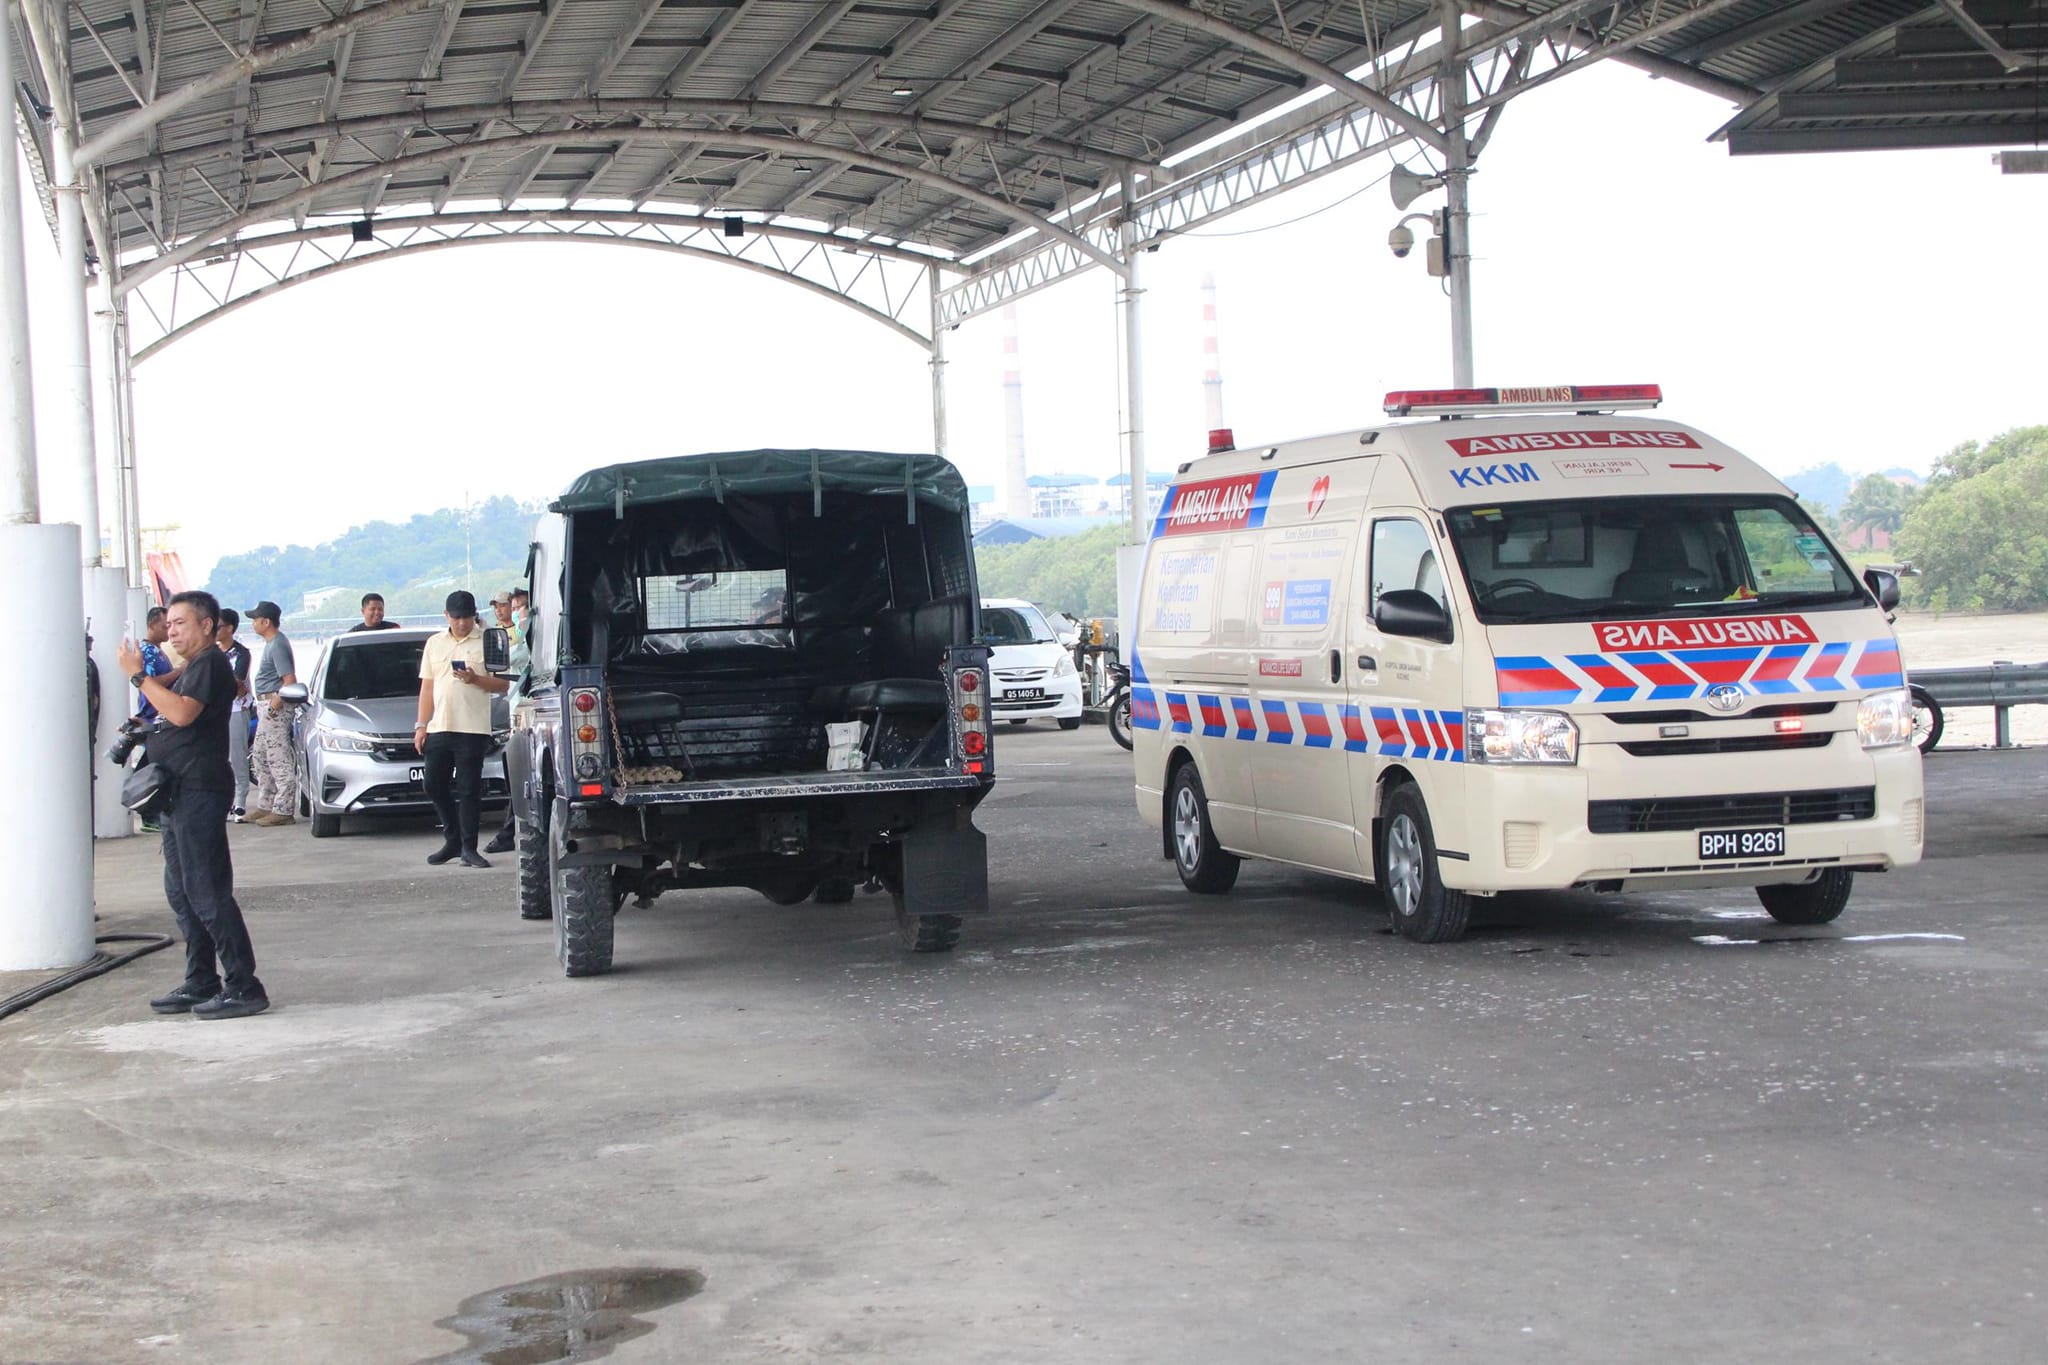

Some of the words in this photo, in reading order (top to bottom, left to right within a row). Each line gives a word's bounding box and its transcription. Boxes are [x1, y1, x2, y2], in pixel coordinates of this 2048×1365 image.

[1501, 387, 1571, 403] AMBULANS
[1469, 431, 1686, 453] AMBULANS
[1450, 462, 1541, 488] KKM
[1170, 483, 1253, 526] AMBULANS
[1266, 587, 1281, 609] 999
[1155, 607, 1192, 634] Malaysia
[1018, 689, 1035, 698] 1405
[1035, 689, 1041, 697] A
[410, 769, 425, 781] QA
[1701, 833, 1738, 857] BPH
[1741, 830, 1784, 854] 9261
